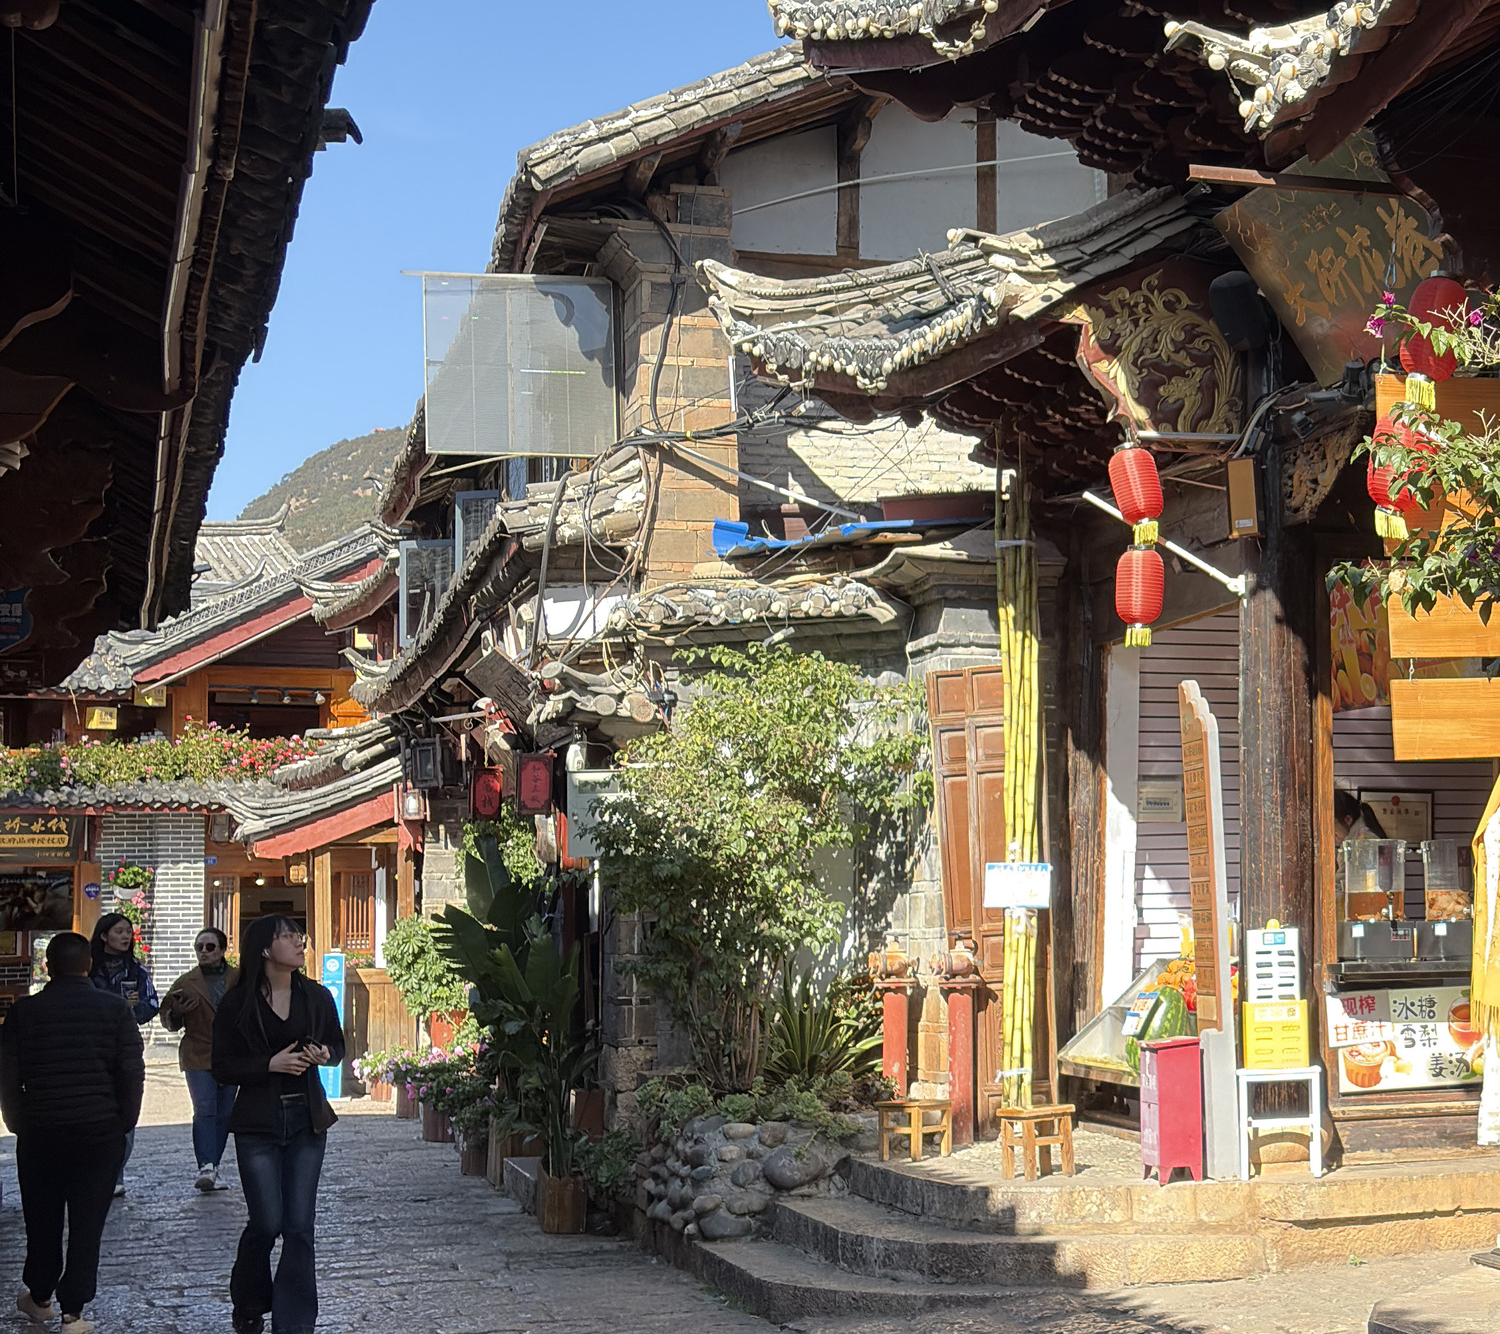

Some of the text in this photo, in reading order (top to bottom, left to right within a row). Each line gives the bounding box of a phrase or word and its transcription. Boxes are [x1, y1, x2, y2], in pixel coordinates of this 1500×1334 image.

[0, 816, 70, 834] 桥米线
[1342, 995, 1376, 1016] 现榨
[1392, 994, 1438, 1020] 冰糖
[1333, 1019, 1387, 1042] 甘蔗汁
[1400, 1023, 1438, 1049] 雪梨
[1429, 1051, 1470, 1079] 姜汤
